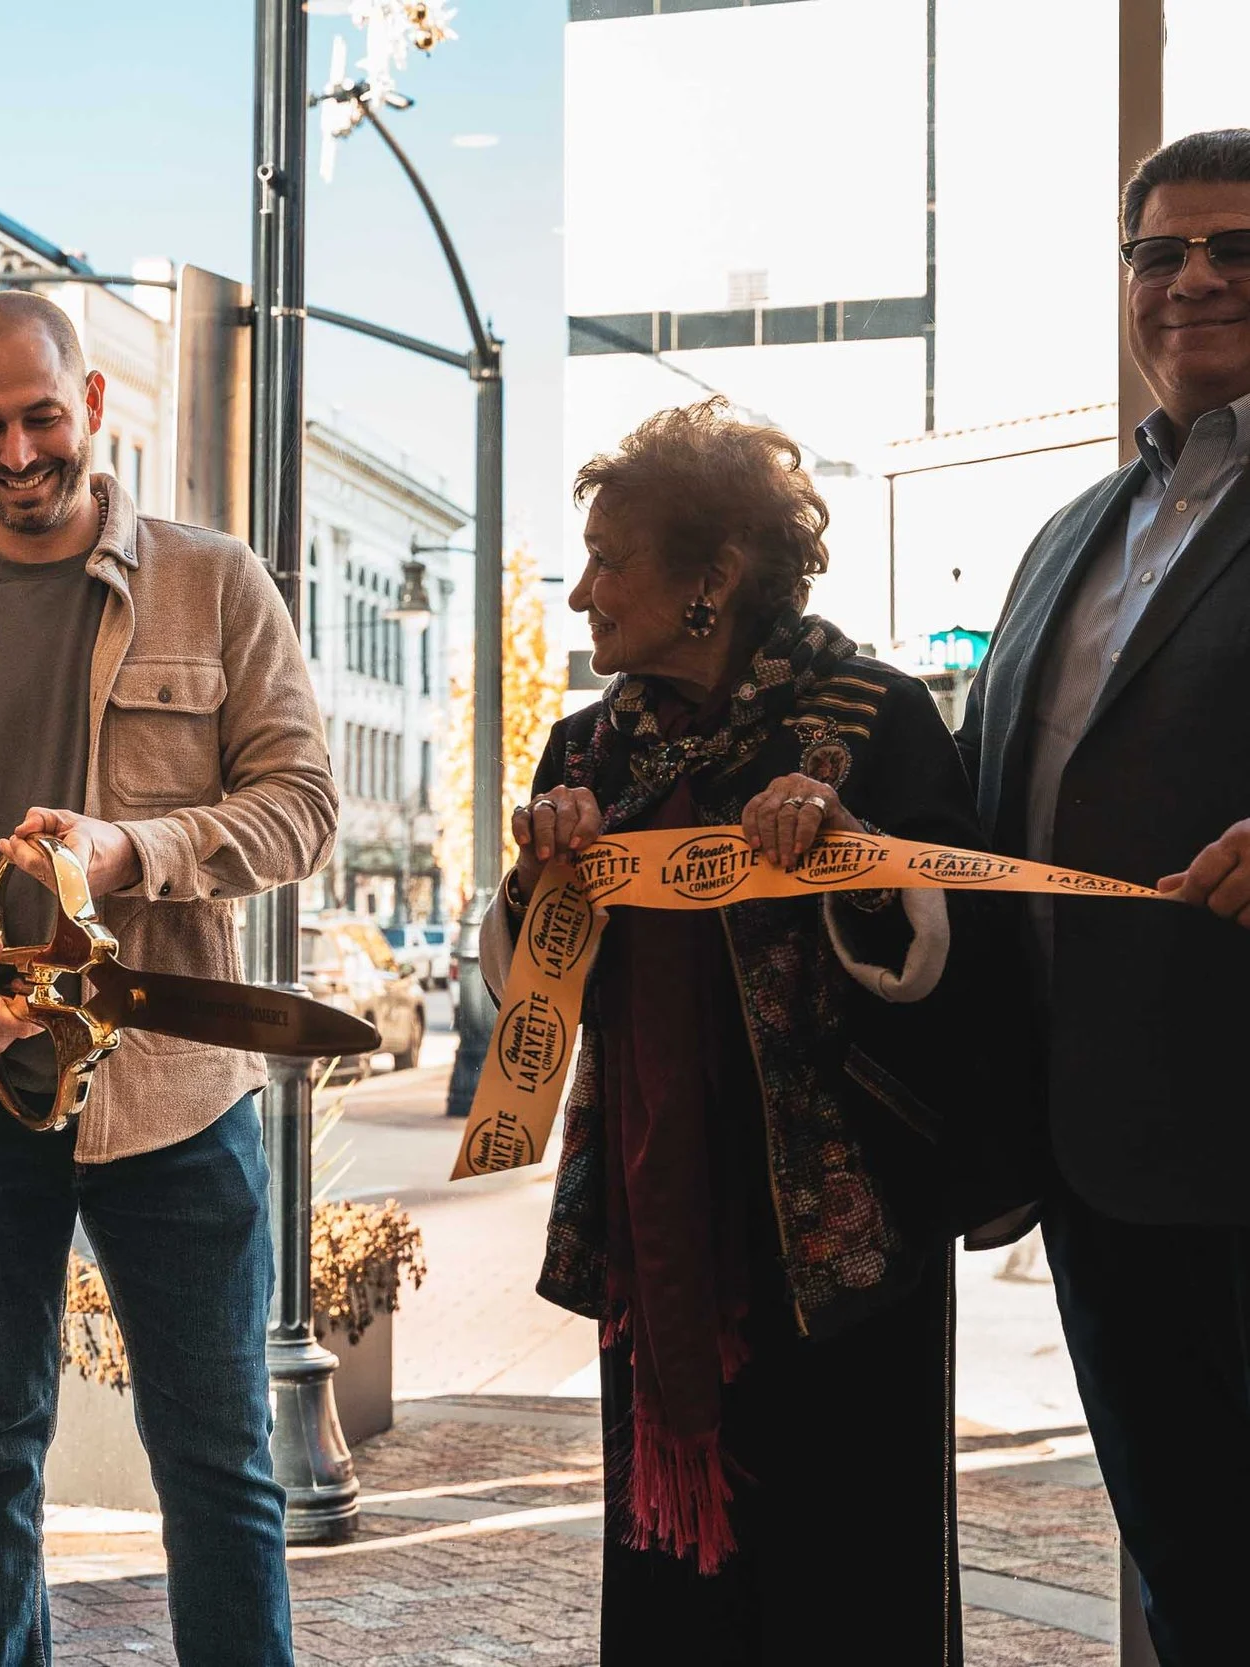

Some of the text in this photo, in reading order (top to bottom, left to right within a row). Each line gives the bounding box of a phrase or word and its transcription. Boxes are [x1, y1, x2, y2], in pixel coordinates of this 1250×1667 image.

[575, 857, 640, 882] AYETTE
[661, 848, 760, 884] LAFAYETTE
[687, 842, 733, 860] Greater
[809, 863, 859, 878] COMMERCE
[907, 858, 1021, 873] LAFAYETTE
[688, 873, 735, 892] COMMERCE
[534, 903, 556, 949] Greater
[544, 882, 582, 980] LAFAYETTE
[566, 910, 586, 957] COMMERCE
[505, 1016, 526, 1064] Greater
[516, 991, 550, 1094] LAFAYETTE
[542, 1021, 557, 1071] COMMERCE
[489, 1110, 517, 1171] FAYETTE
